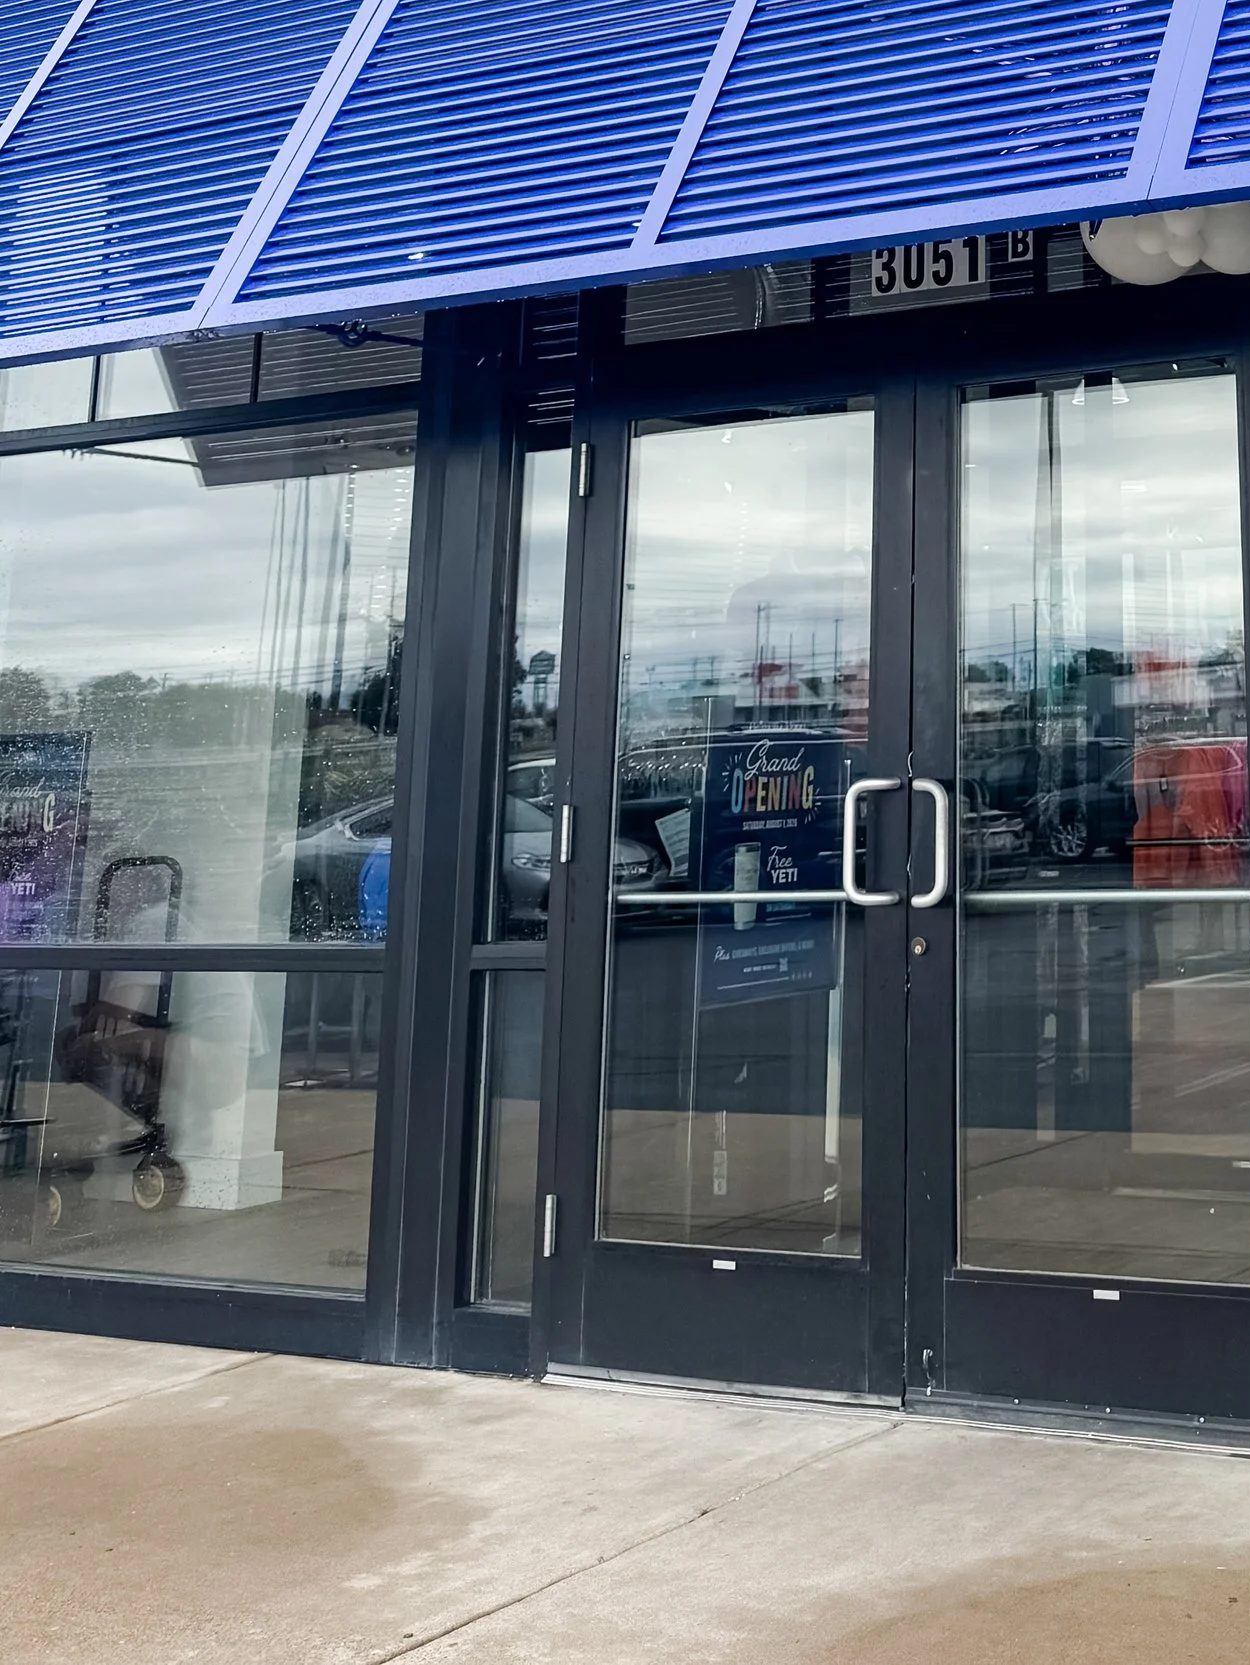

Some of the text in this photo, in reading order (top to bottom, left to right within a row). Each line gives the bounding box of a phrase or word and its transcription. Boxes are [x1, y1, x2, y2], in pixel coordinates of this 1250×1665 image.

[875, 230, 1031, 293] 3051 B
[744, 739, 805, 780] Grand
[731, 765, 815, 814] OPENING
[767, 845, 793, 872] Free
[10, 882, 36, 895] YETI
[771, 868, 798, 884] YETI
